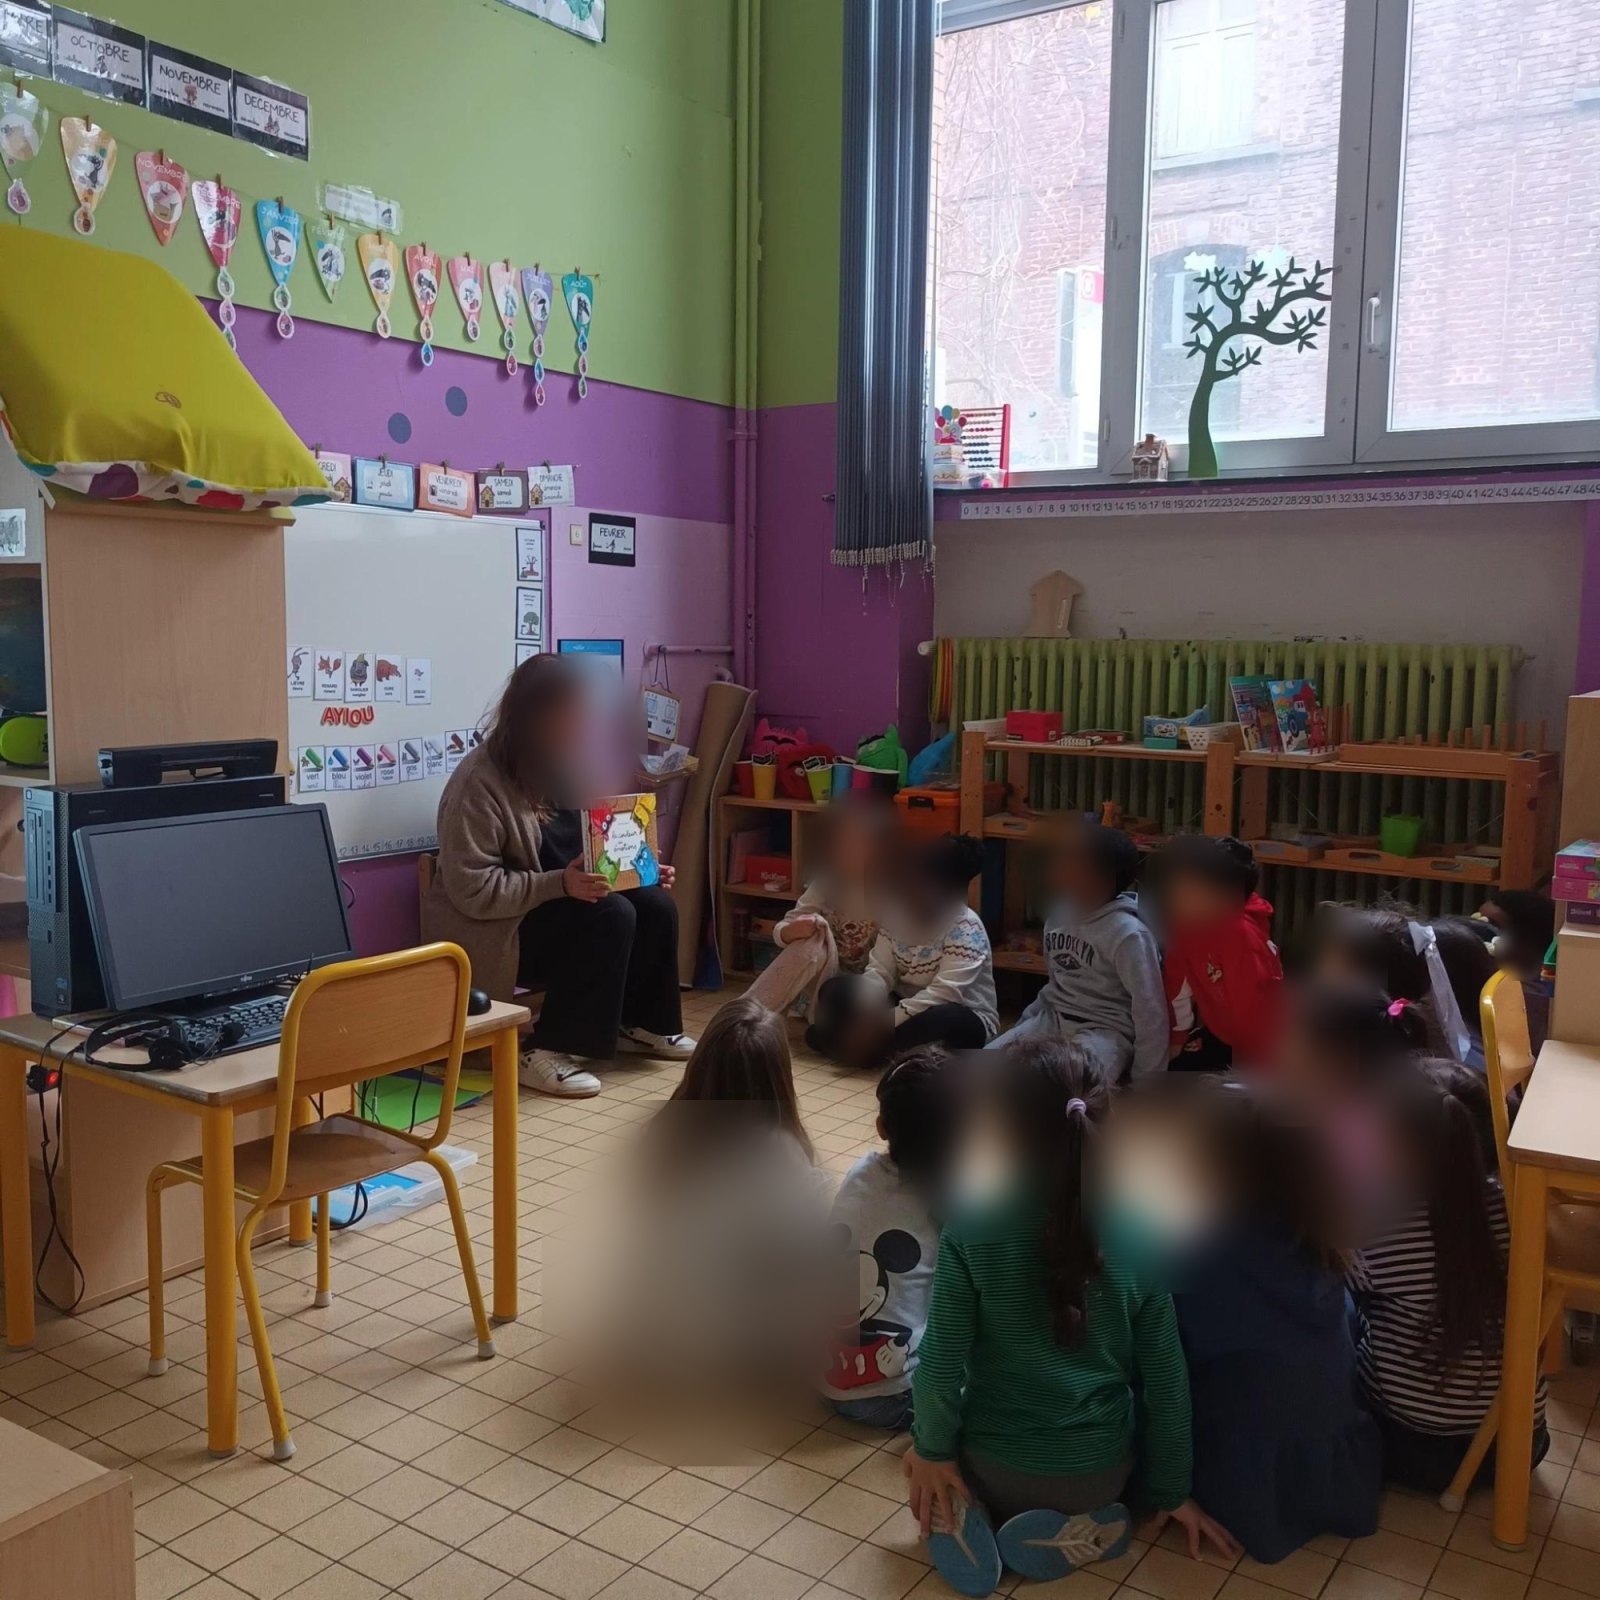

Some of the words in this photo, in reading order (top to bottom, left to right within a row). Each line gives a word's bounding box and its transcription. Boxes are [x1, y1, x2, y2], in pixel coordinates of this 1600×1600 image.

[70, 35, 130, 63] OCTOBRE
[159, 64, 221, 95] NOVEMBRE
[244, 93, 299, 124] DECEMBRE
[434, 475, 462, 488] VENDREDI
[494, 478, 513, 488] SAMEDI
[963, 506, 969, 514] 0
[984, 506, 990, 515] 2
[995, 506, 1000, 514] 3
[1005, 505, 1011, 513] 4
[1016, 505, 1021, 513] 5
[1026, 504, 1033, 513] 6
[1038, 504, 1044, 513] 7
[1049, 504, 1054, 513] 8
[1059, 504, 1066, 513] 9
[1070, 503, 1079, 512] 10
[1081, 503, 1089, 512] 11
[1092, 503, 1101, 511] 12
[1103, 503, 1112, 511] 13
[1115, 502, 1124, 510] 14
[1126, 501, 1136, 510] 15
[1138, 501, 1148, 510] 16
[1150, 501, 1159, 509] 17
[1161, 500, 1171, 509] 18
[1174, 500, 1183, 508] 19
[1184, 499, 1195, 508] 20
[1196, 499, 1207, 508] 21
[1209, 499, 1220, 507] 22
[1221, 497, 1233, 507] 23
[1233, 497, 1245, 507] 24
[1246, 497, 1258, 506] 25
[1259, 497, 1271, 506] 26
[1272, 496, 1283, 505] 27
[1285, 496, 1296, 505] 28
[1298, 495, 1310, 505] 29
[1311, 495, 1323, 504] 30
[1325, 495, 1336, 503] 31
[1338, 494, 1351, 503] 32
[1351, 493, 1364, 502] 33
[1366, 492, 1378, 502] 34
[1379, 492, 1392, 502] 35
[1394, 491, 1406, 501] 36
[1407, 491, 1420, 500] 37
[1422, 490, 1434, 500] 38
[1436, 490, 1450, 500] 39
[1451, 489, 1464, 499] 40
[1466, 489, 1478, 498] 41
[1481, 488, 1494, 498] 42
[1495, 487, 1509, 497] 43
[1511, 487, 1524, 496] 44
[1526, 487, 1540, 496] 45
[1541, 486, 1555, 496] 46
[1557, 485, 1571, 495] 47
[1573, 484, 1587, 494] 48
[320, 705, 375, 728] AYIOU
[426, 760, 443, 768] blanc
[331, 772, 346, 780] bleu
[355, 772, 372, 780] violet
[373, 842, 380, 850] 15
[1045, 932, 1095, 966] BROOKLYN
